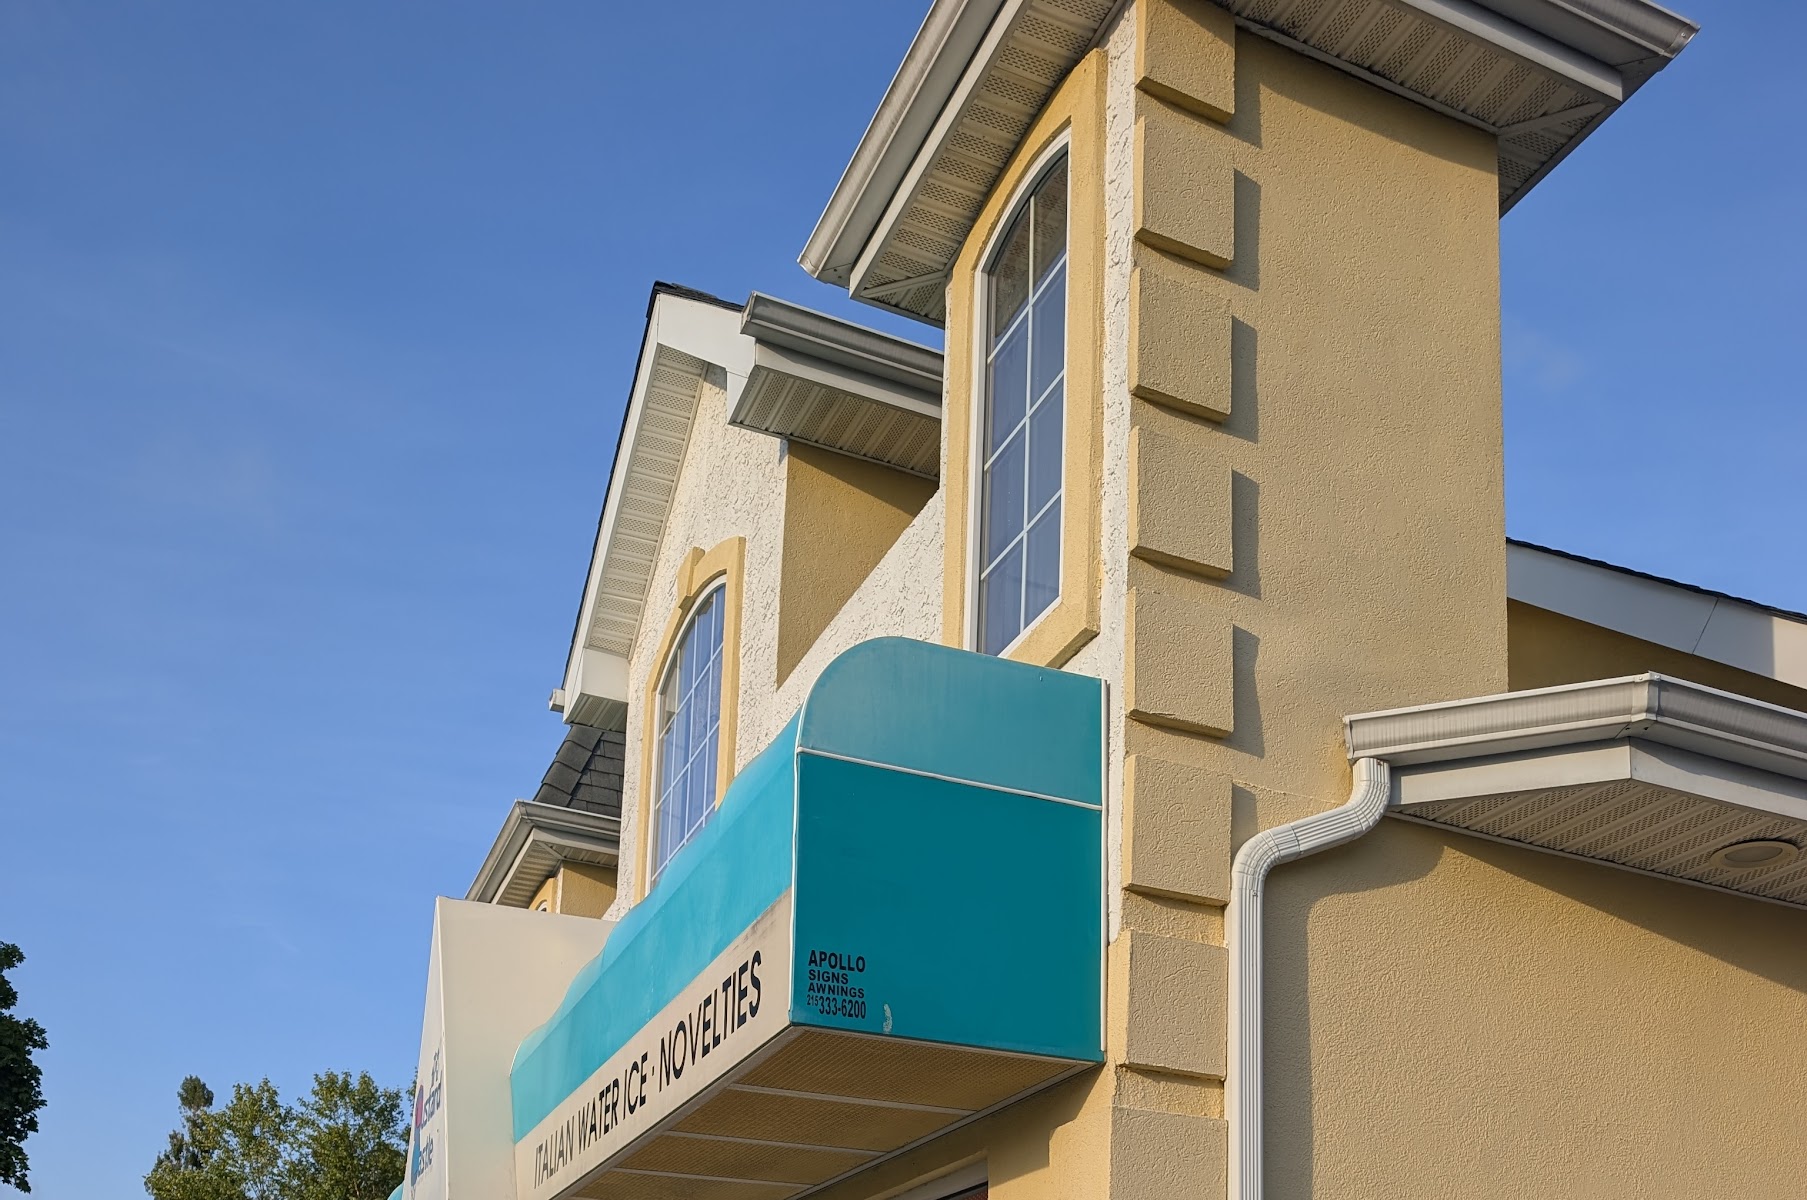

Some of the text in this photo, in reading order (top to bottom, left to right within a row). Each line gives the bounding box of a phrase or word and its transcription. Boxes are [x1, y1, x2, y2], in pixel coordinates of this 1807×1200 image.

[808, 949, 866, 973] APOLLO
[808, 969, 849, 985] SIGNS
[808, 982, 865, 999] AWNINGS
[534, 950, 762, 1190] ITALIAN WATER ICE NOVELTIES
